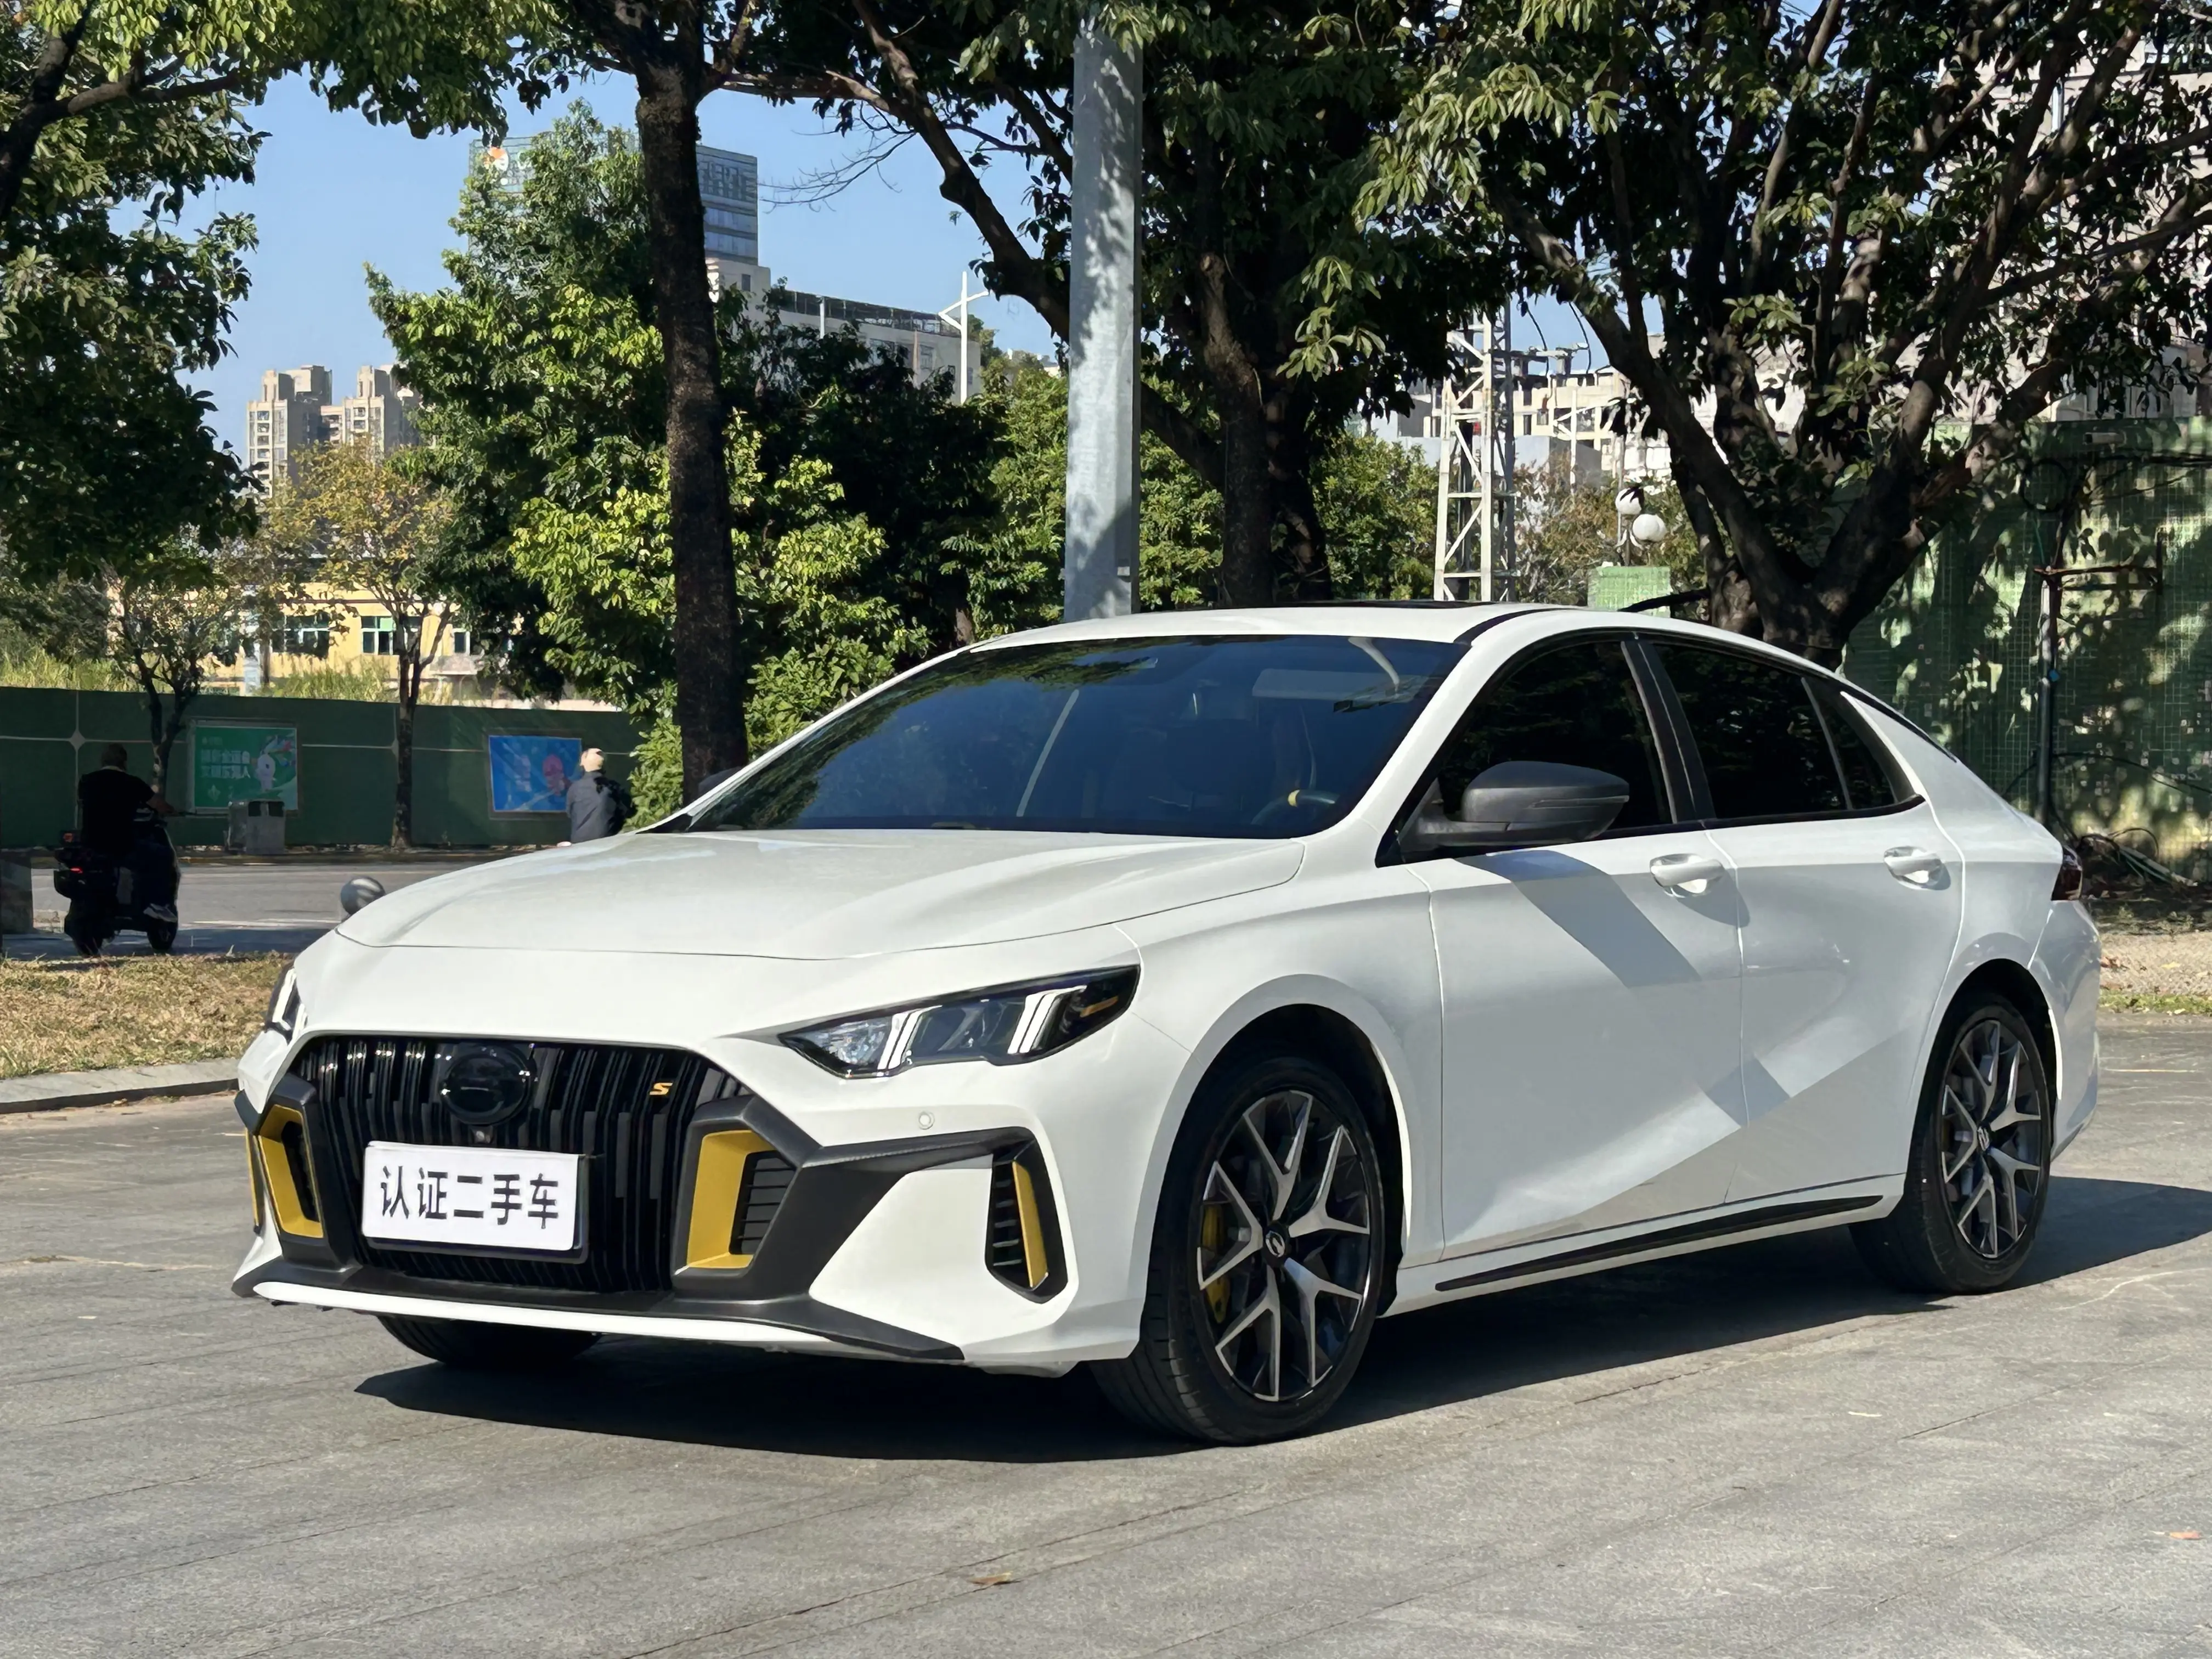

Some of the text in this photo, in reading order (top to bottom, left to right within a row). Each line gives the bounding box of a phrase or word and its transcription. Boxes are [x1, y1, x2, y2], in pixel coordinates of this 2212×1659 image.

[649, 1082, 673, 1096] S
[380, 1165, 558, 1229] 认证二手车
